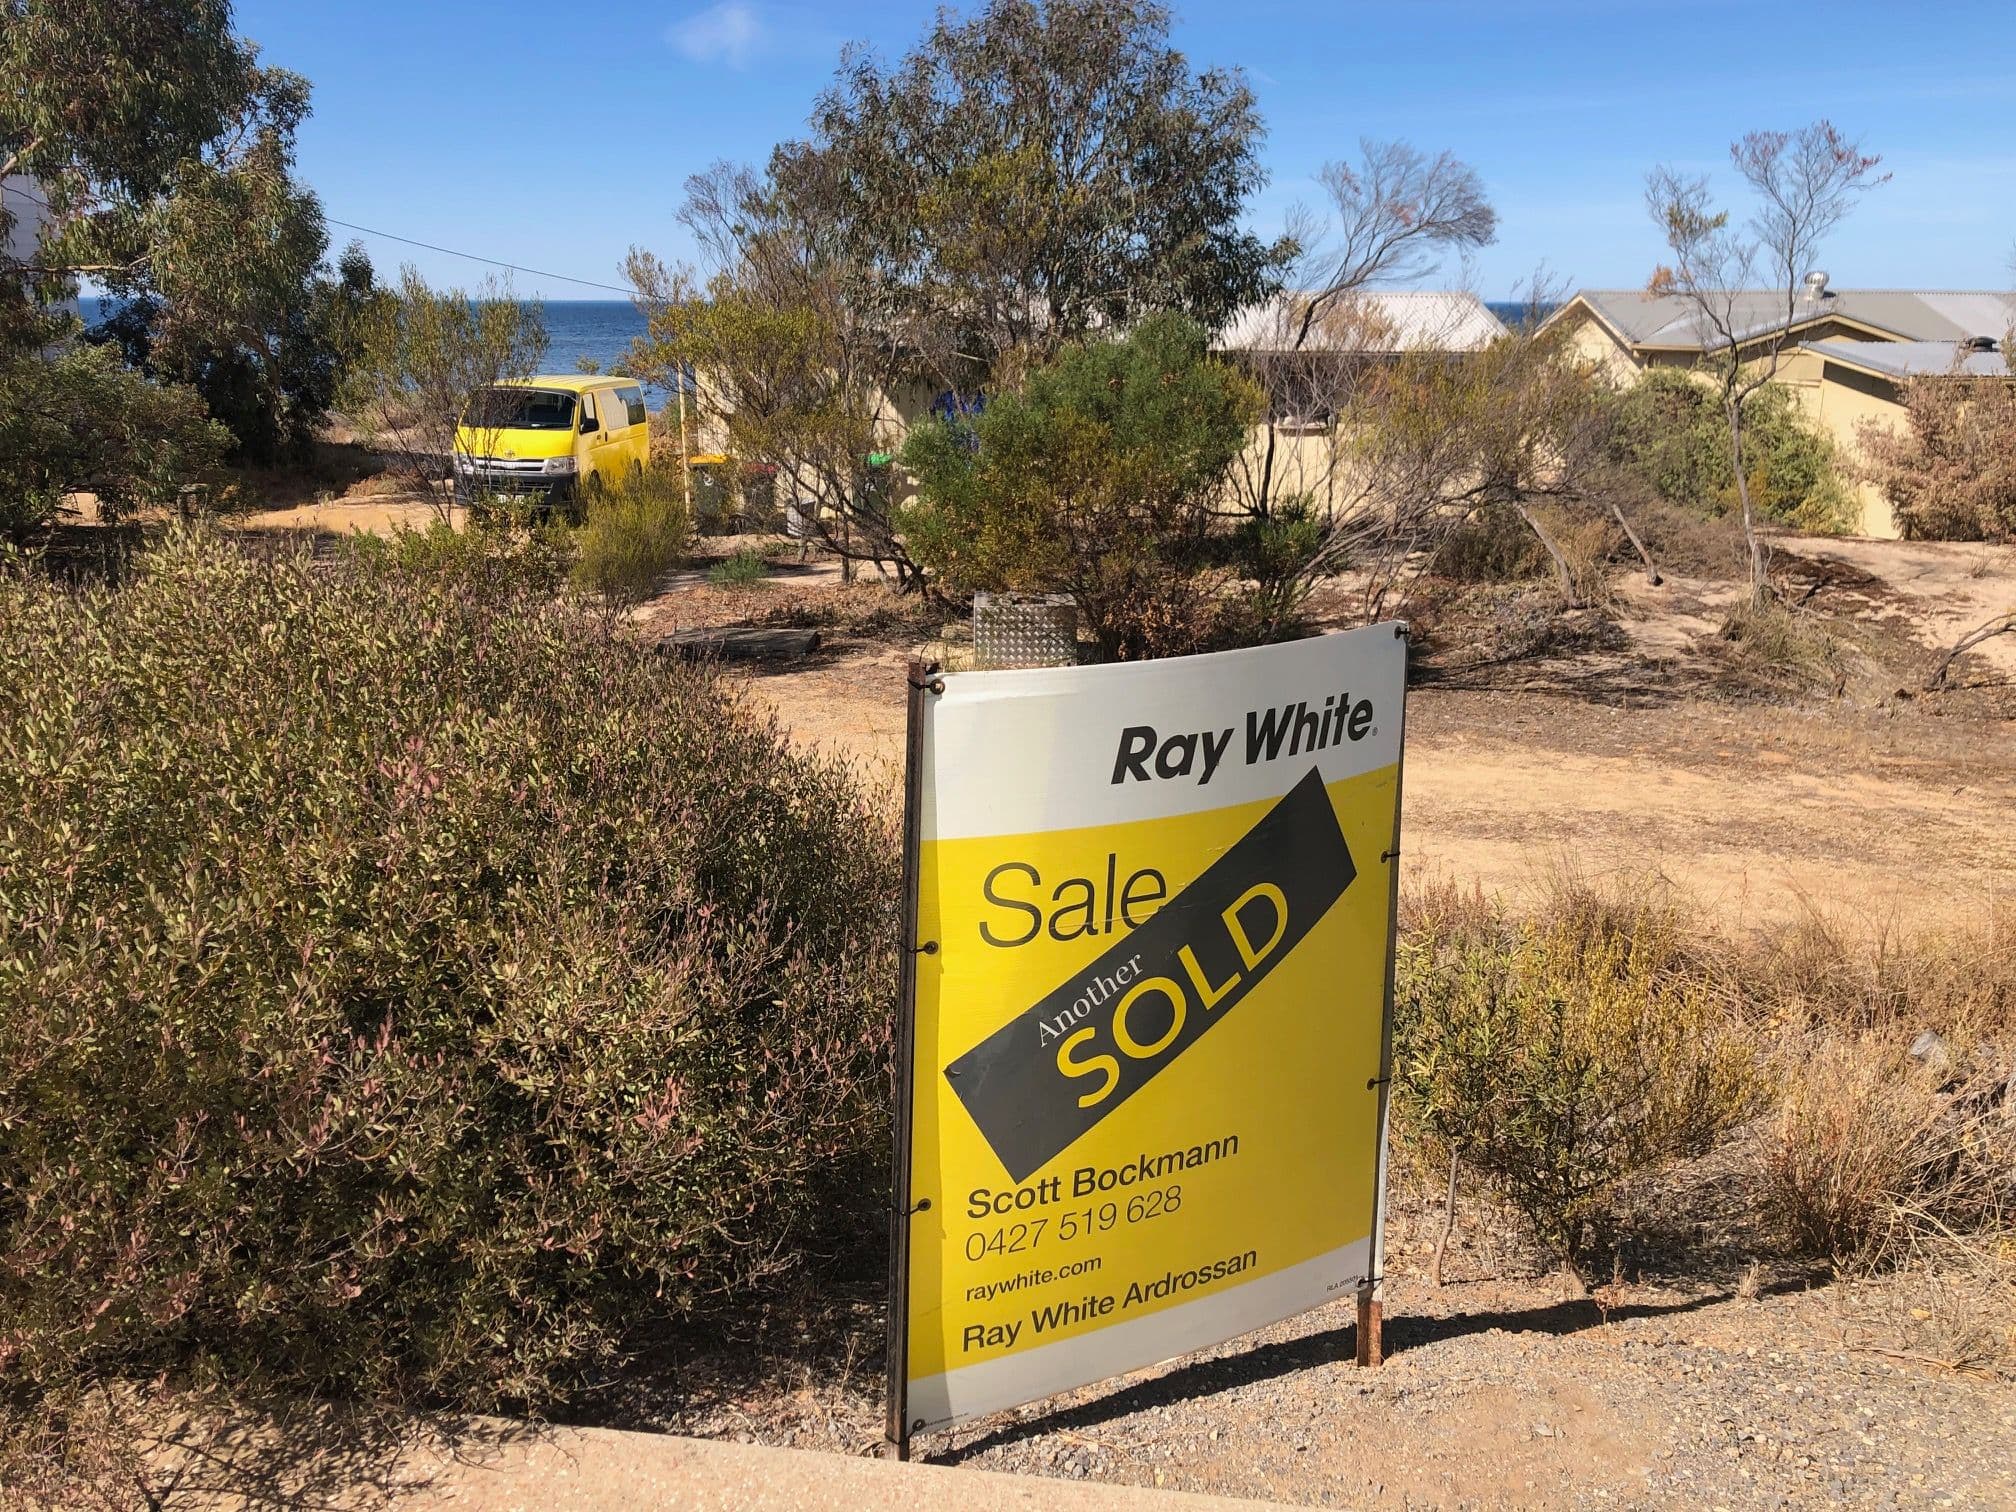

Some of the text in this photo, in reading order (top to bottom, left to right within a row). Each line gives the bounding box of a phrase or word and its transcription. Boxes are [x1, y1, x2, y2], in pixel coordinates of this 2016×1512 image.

[1111, 692, 1374, 785] Ray White
[979, 853, 1167, 948] Sale
[1038, 954, 1143, 1047] Another
[1057, 883, 1288, 1108] SOLD
[967, 1134, 1239, 1219] Scott Bockmann
[965, 1185, 1182, 1262] 0427 519 628
[963, 1249, 1257, 1352] Ray White Ardrossan
[966, 1256, 1102, 1302] raywhite.com
